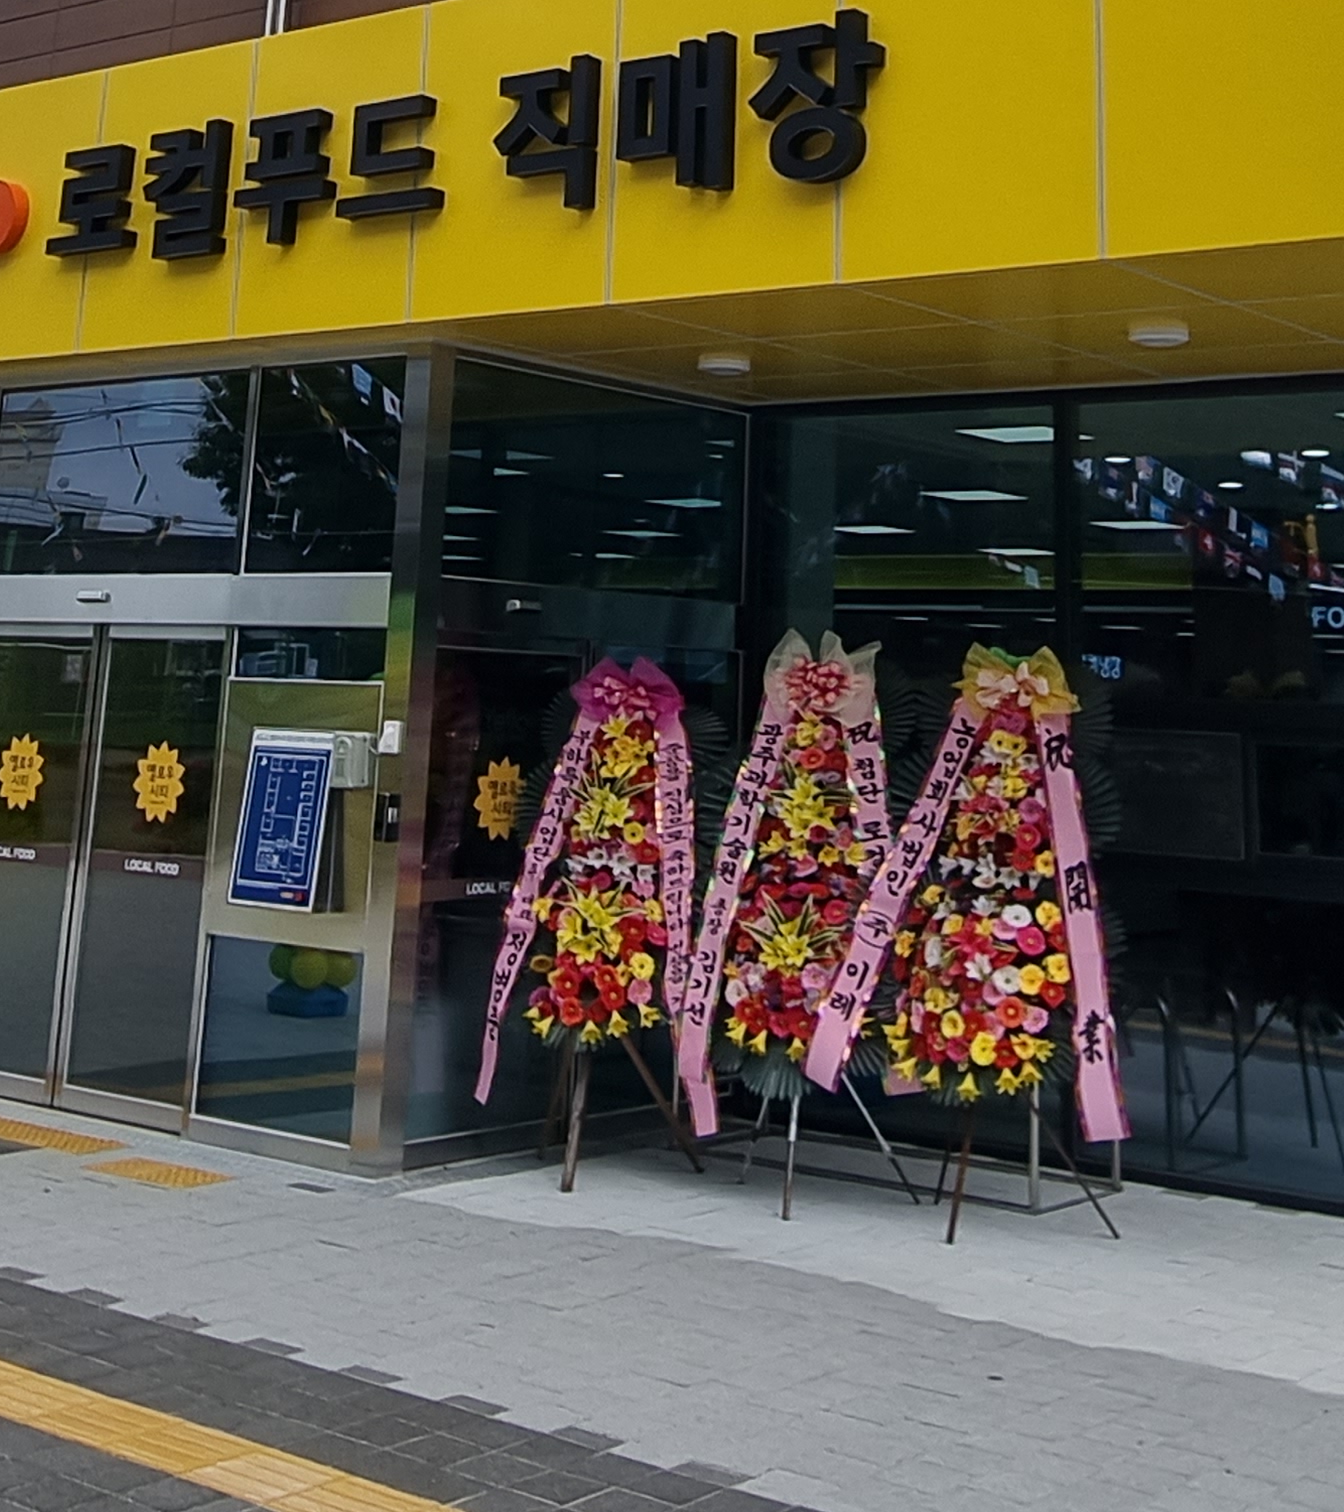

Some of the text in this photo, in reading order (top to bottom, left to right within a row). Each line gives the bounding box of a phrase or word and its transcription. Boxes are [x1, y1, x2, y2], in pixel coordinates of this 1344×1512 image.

[44, 7, 886, 262] 로컬푸드 직매장
[717, 723, 784, 885] 광주과학기술원
[854, 757, 884, 804] 첨단
[885, 717, 977, 897] 농업회사법인
[13, 847, 37, 860] FOOD
[124, 859, 180, 876] LOCAL FOOD
[466, 881, 497, 895] LOCAL
[685, 949, 717, 1026] 김기선
